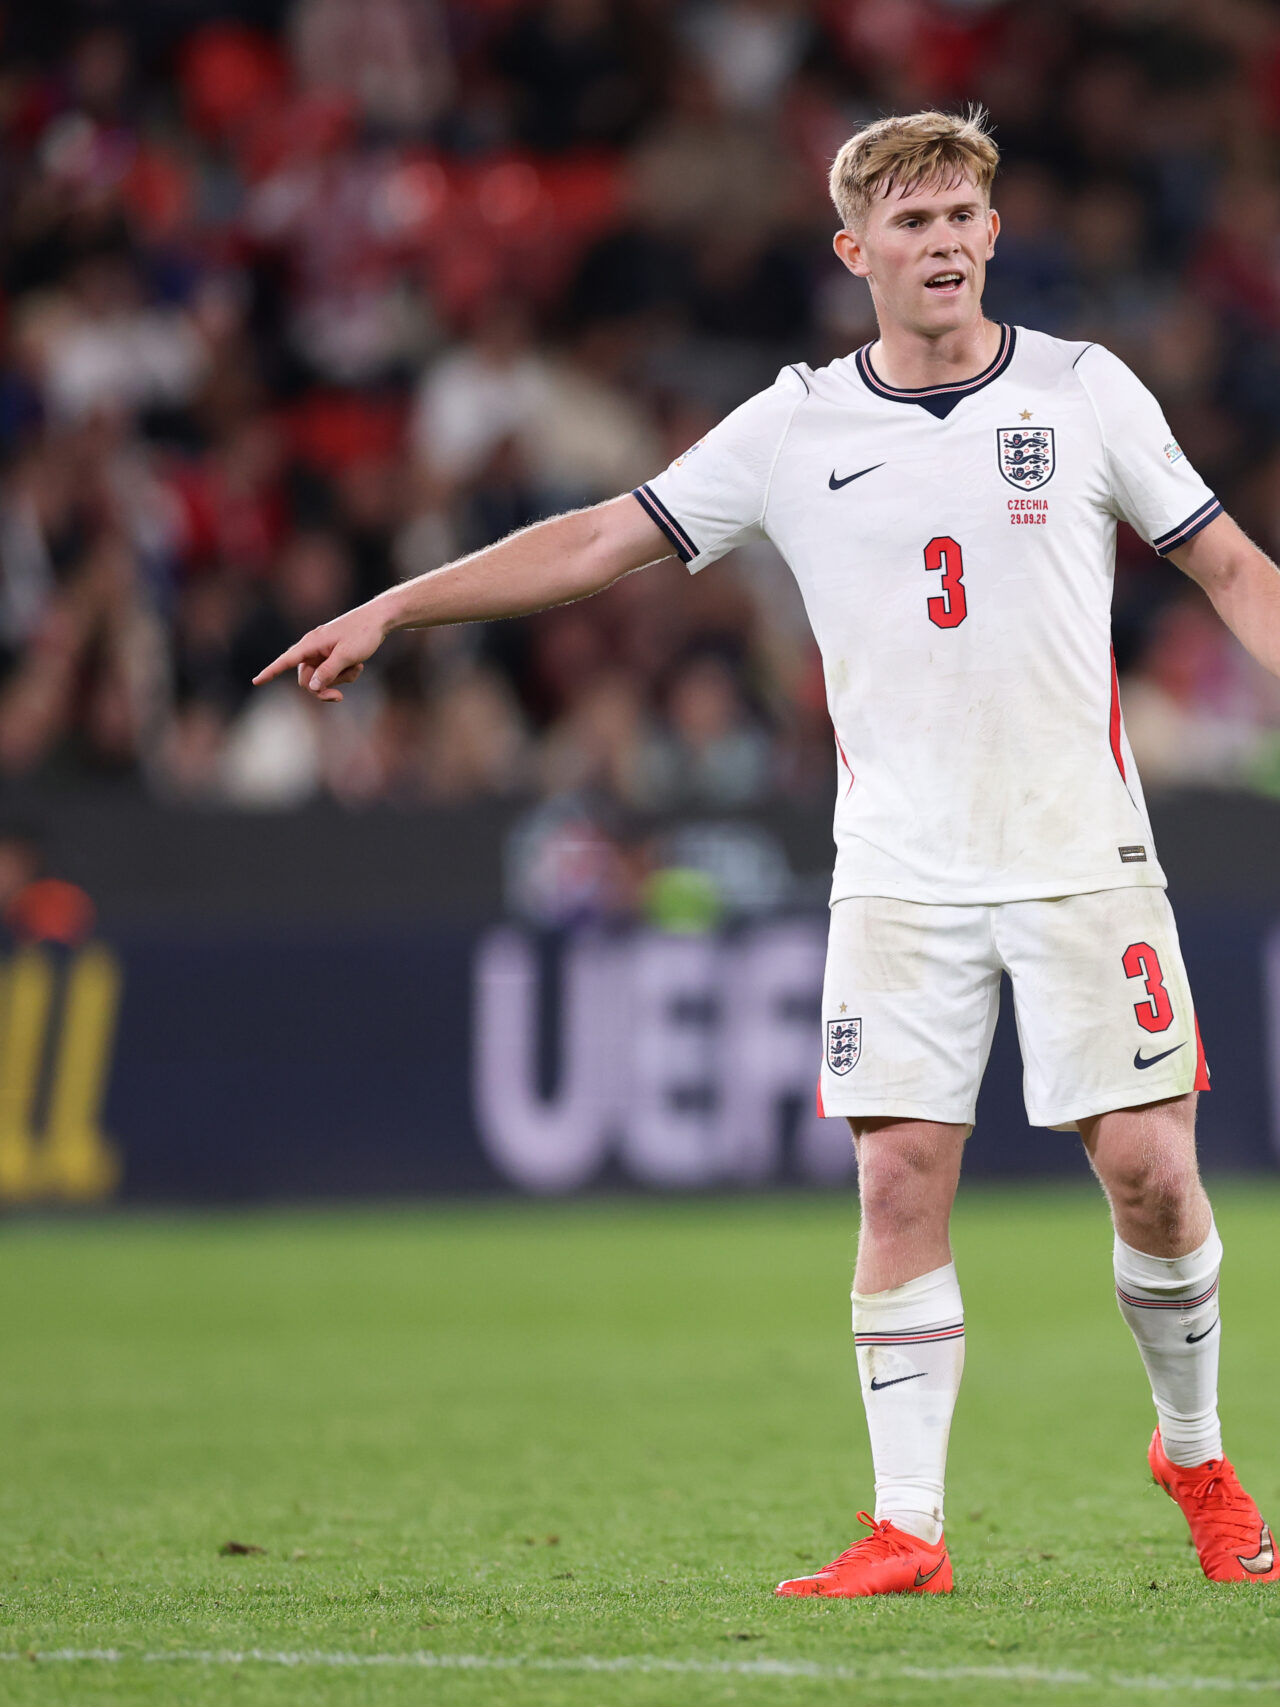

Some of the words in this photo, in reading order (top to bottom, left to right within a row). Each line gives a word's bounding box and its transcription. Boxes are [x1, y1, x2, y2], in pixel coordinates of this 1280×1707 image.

[1007, 499, 1049, 510] CZECHIA
[1010, 513, 1047, 525] 29.09.26
[923, 535, 968, 629] 3
[1121, 941, 1174, 1034] 3
